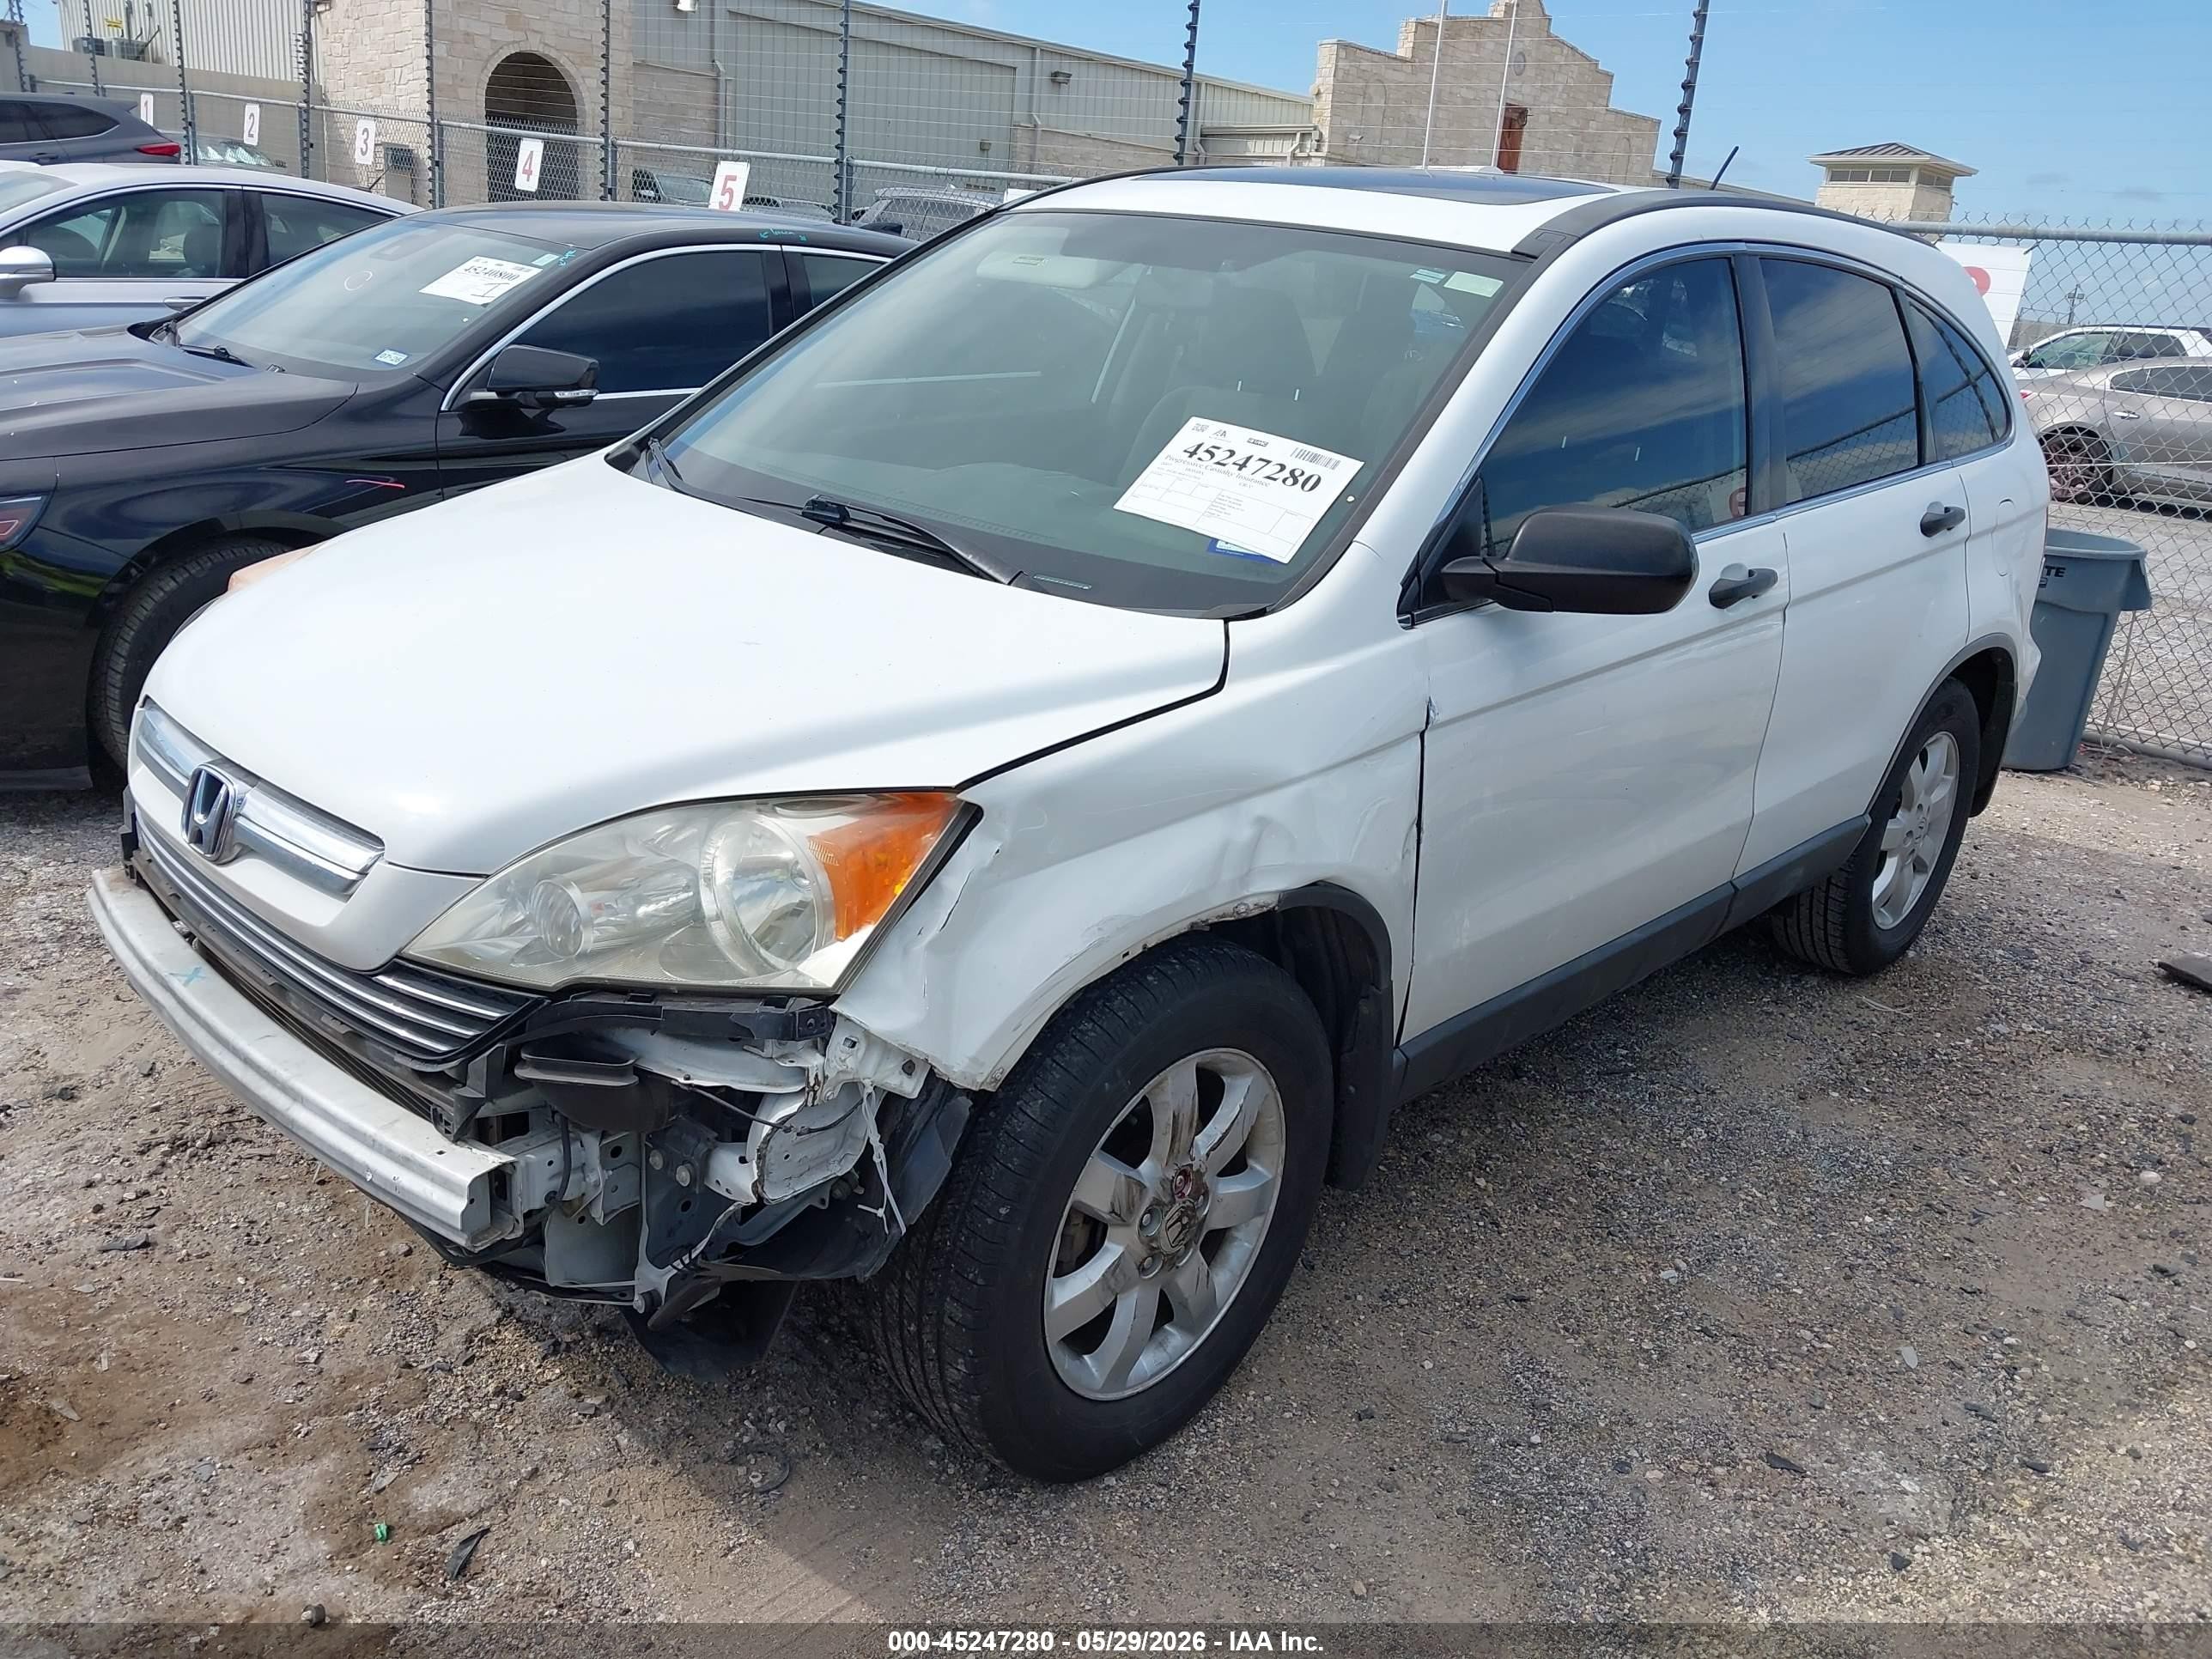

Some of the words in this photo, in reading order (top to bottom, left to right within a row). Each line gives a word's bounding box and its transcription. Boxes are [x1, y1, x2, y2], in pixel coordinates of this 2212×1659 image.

[247, 112, 255, 138] 2
[360, 127, 369, 156] 3
[521, 150, 534, 182] 4
[719, 174, 738, 210] 5
[1182, 441, 1322, 493] 45247280
[1236, 472, 1271, 489] Insurance
[2045, 565, 2066, 578] TE
